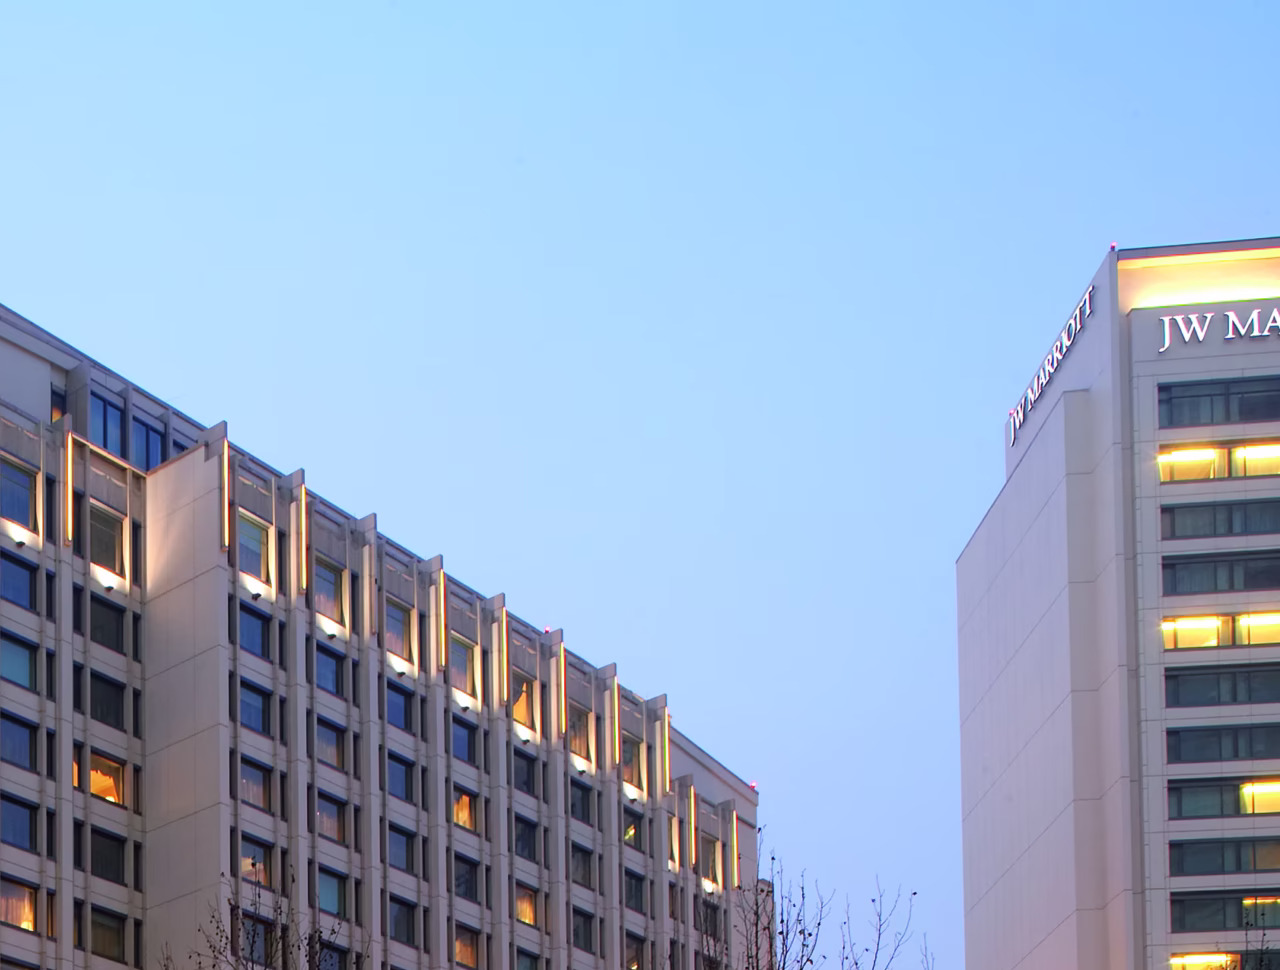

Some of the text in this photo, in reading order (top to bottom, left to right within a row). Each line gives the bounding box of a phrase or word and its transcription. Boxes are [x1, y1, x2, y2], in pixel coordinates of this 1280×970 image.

[1010, 285, 1095, 447] JW MARRIOTT
[1158, 307, 1280, 353] JW MA
